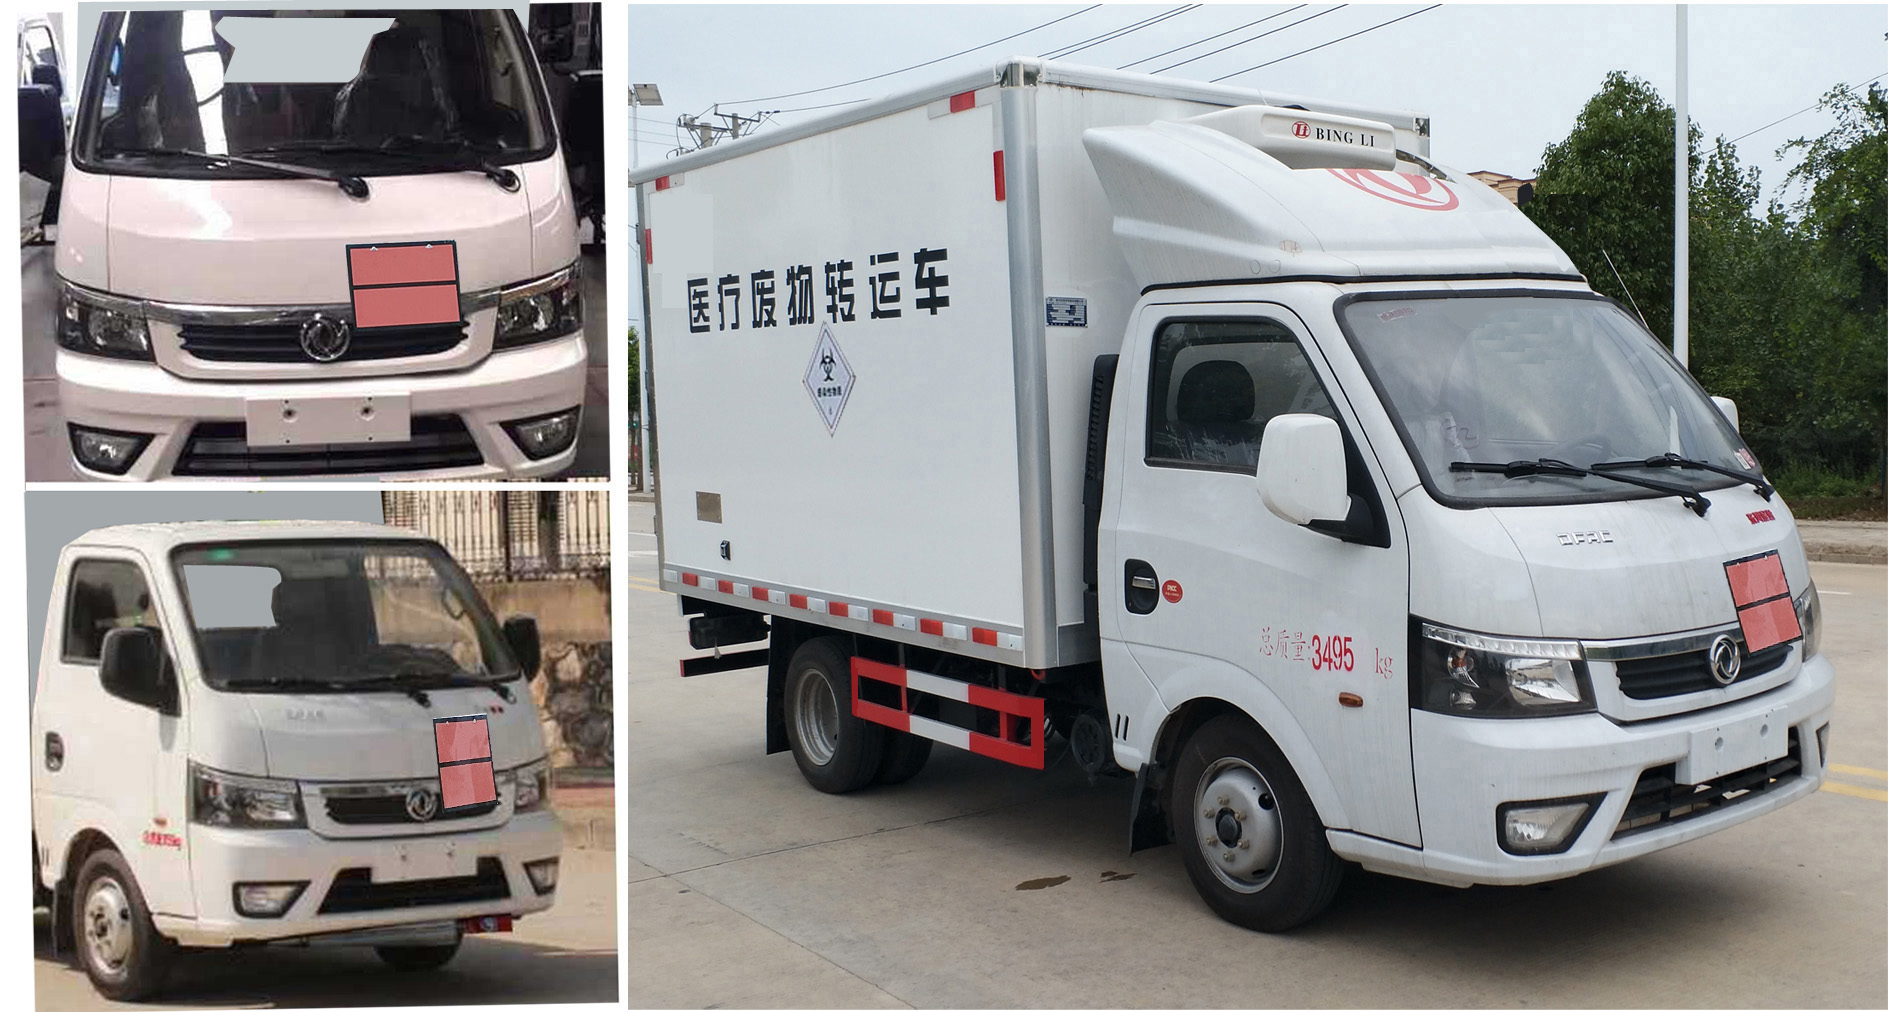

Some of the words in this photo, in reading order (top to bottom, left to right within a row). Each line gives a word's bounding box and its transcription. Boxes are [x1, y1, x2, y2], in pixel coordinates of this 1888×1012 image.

[1316, 127, 1353, 144] BING
[1361, 133, 1375, 147] LI
[687, 247, 951, 334] 医疗废物转运车
[1375, 647, 1393, 680] kg
